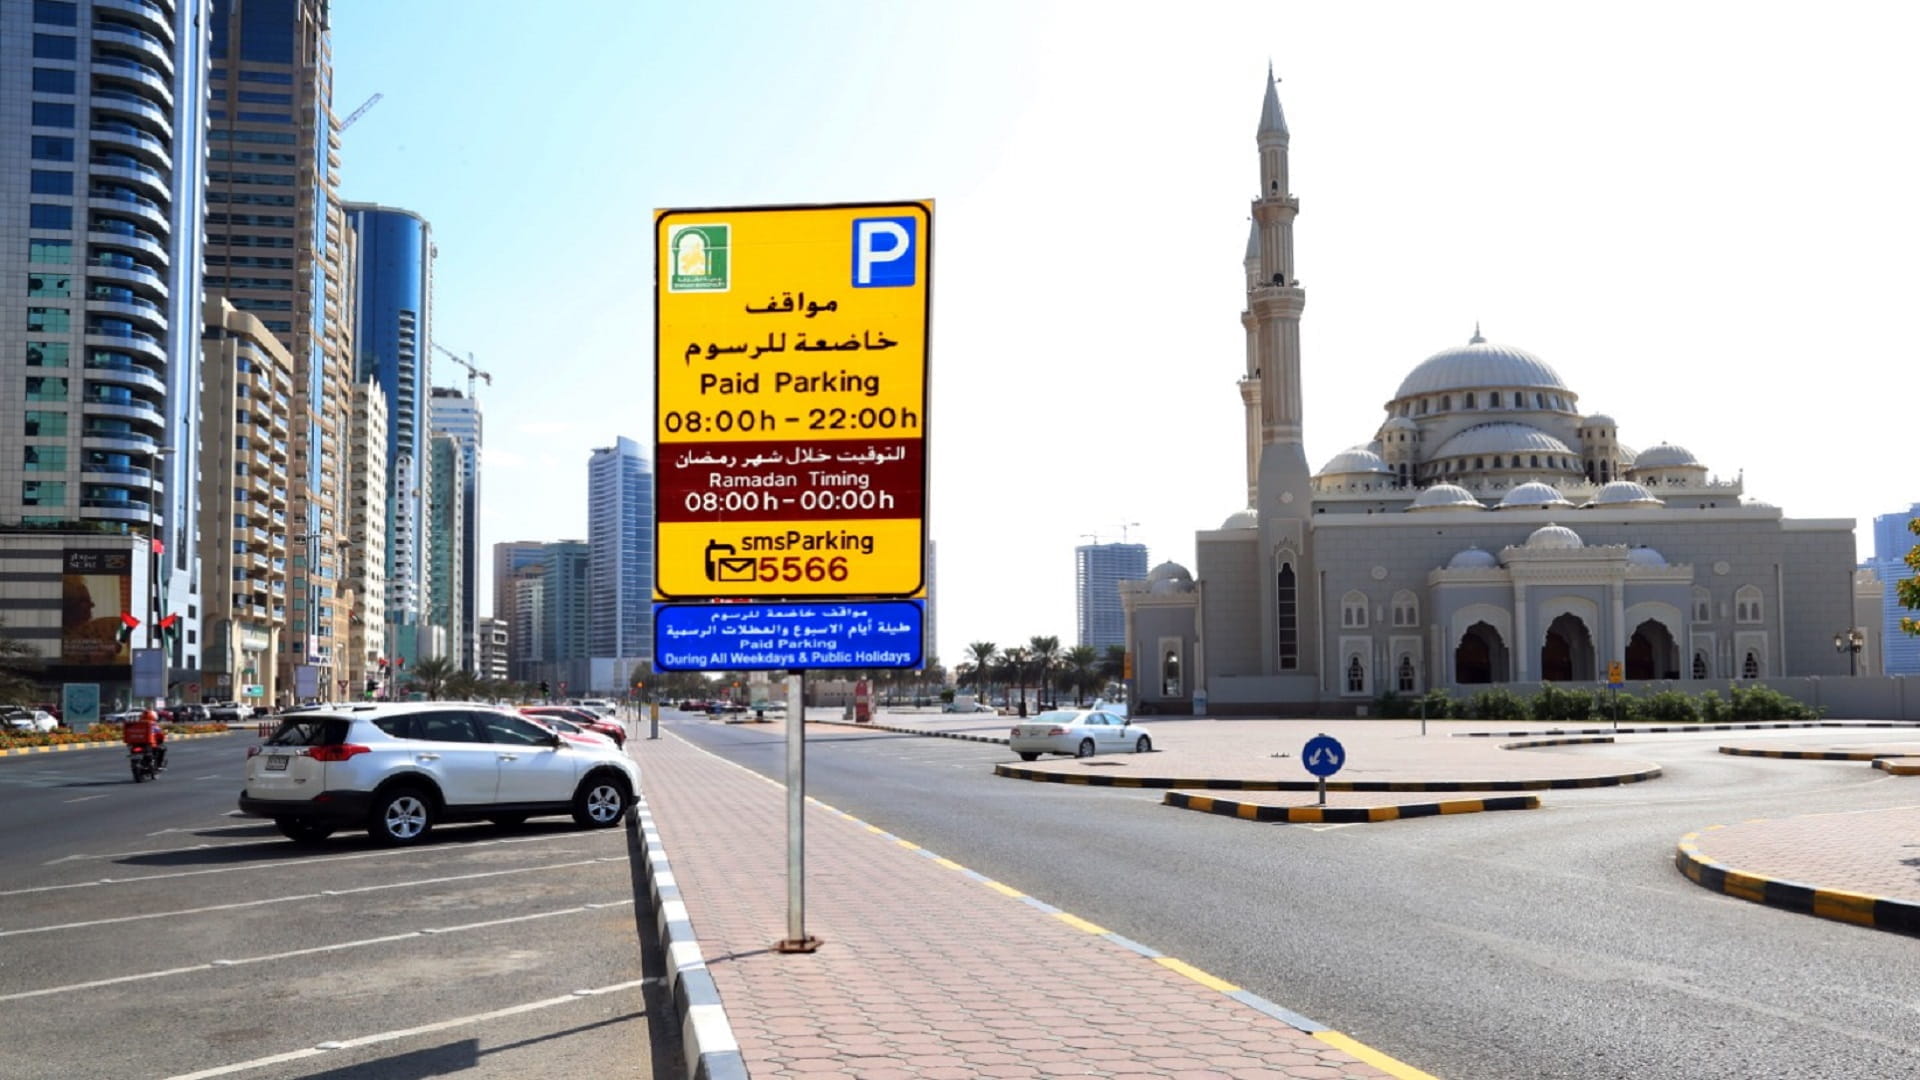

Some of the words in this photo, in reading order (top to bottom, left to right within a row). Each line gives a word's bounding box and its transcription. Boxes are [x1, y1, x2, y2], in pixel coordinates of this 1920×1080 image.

[858, 221, 910, 284] P
[745, 292, 838, 318] مواقف
[684, 332, 786, 367] للرسوم
[794, 330, 898, 352] خاضعة
[701, 373, 759, 395] Paid
[775, 369, 880, 397] Parking
[665, 409, 775, 432] 08:00h
[808, 406, 917, 430] 22:00h
[675, 448, 737, 468] رمضان
[741, 450, 783, 468] شهر
[785, 446, 832, 465] خلال
[836, 445, 906, 465] التوقيت
[709, 471, 797, 488] Ramadan
[808, 470, 869, 489] Timing
[741, 530, 874, 554] smsParking
[758, 556, 849, 582] 5566
[711, 610, 760, 622] للرسوم
[766, 608, 816, 618] خاضعة
[822, 606, 868, 618] مواقف
[666, 624, 717, 639] الرسمية
[740, 639, 774, 650] Paid
[777, 638, 838, 650] Parking
[665, 652, 707, 667] During
[710, 652, 727, 664] All
[730, 651, 795, 667] Weekdays
[798, 651, 808, 663] &
[811, 650, 852, 663] Public
[855, 650, 911, 665] Holidays
